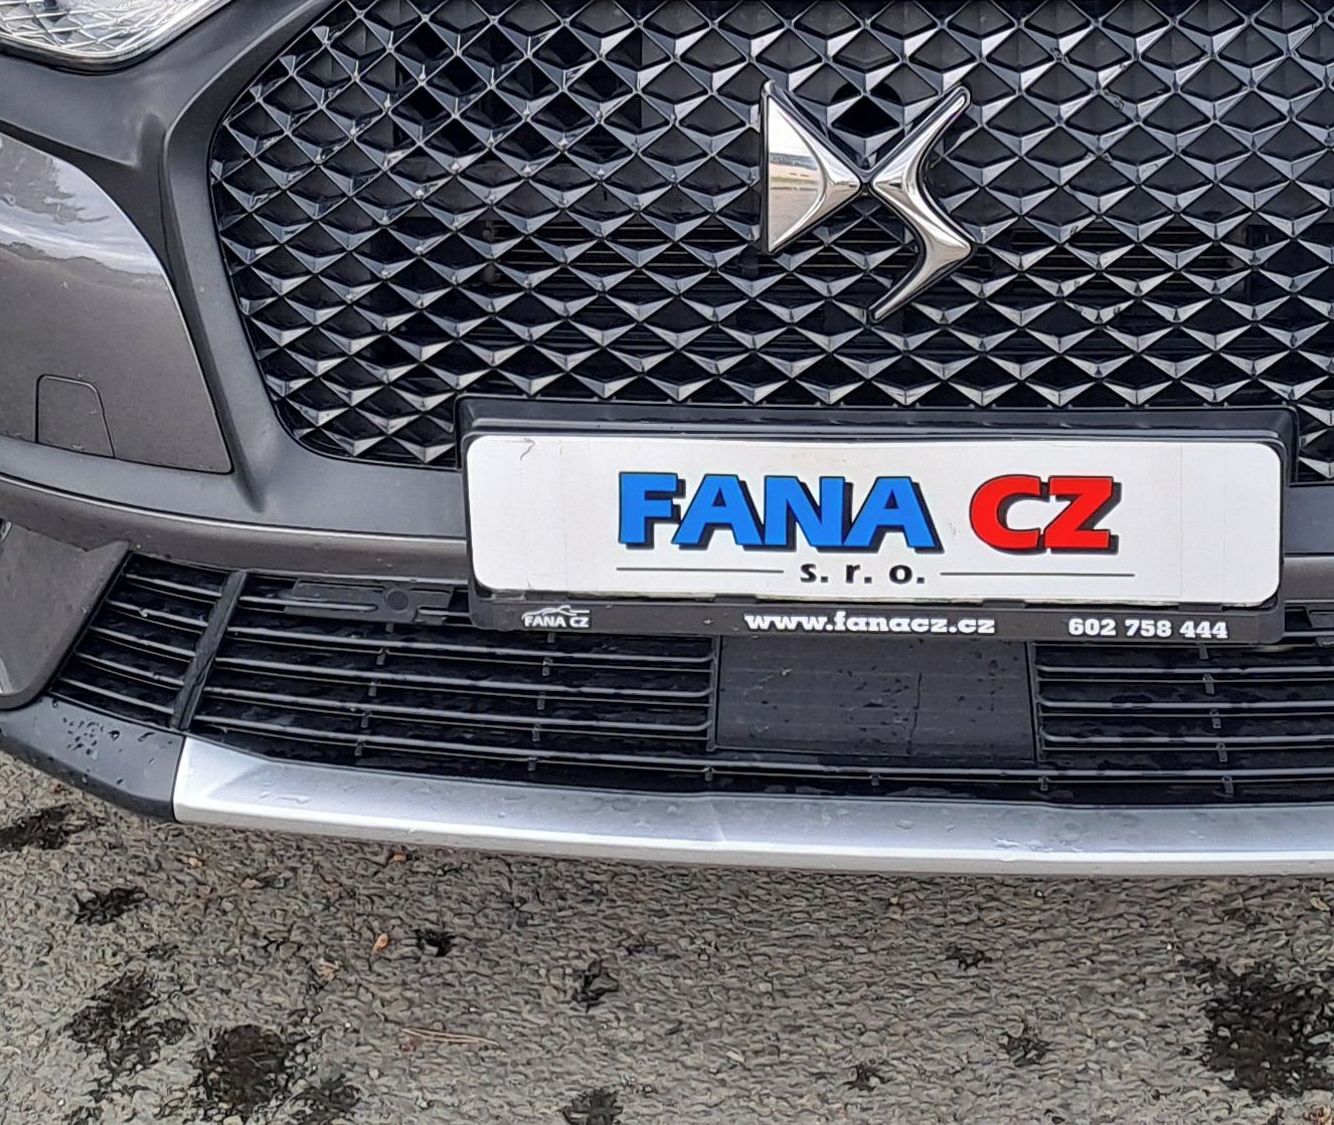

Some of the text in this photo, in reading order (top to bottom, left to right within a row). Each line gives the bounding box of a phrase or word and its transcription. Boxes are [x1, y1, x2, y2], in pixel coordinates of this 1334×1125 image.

[618, 471, 1122, 555] FANA CZ
[524, 615, 589, 628] FANA CZ
[744, 611, 996, 634] www.fanacz.cz
[1068, 618, 1229, 639] 602 758 444
